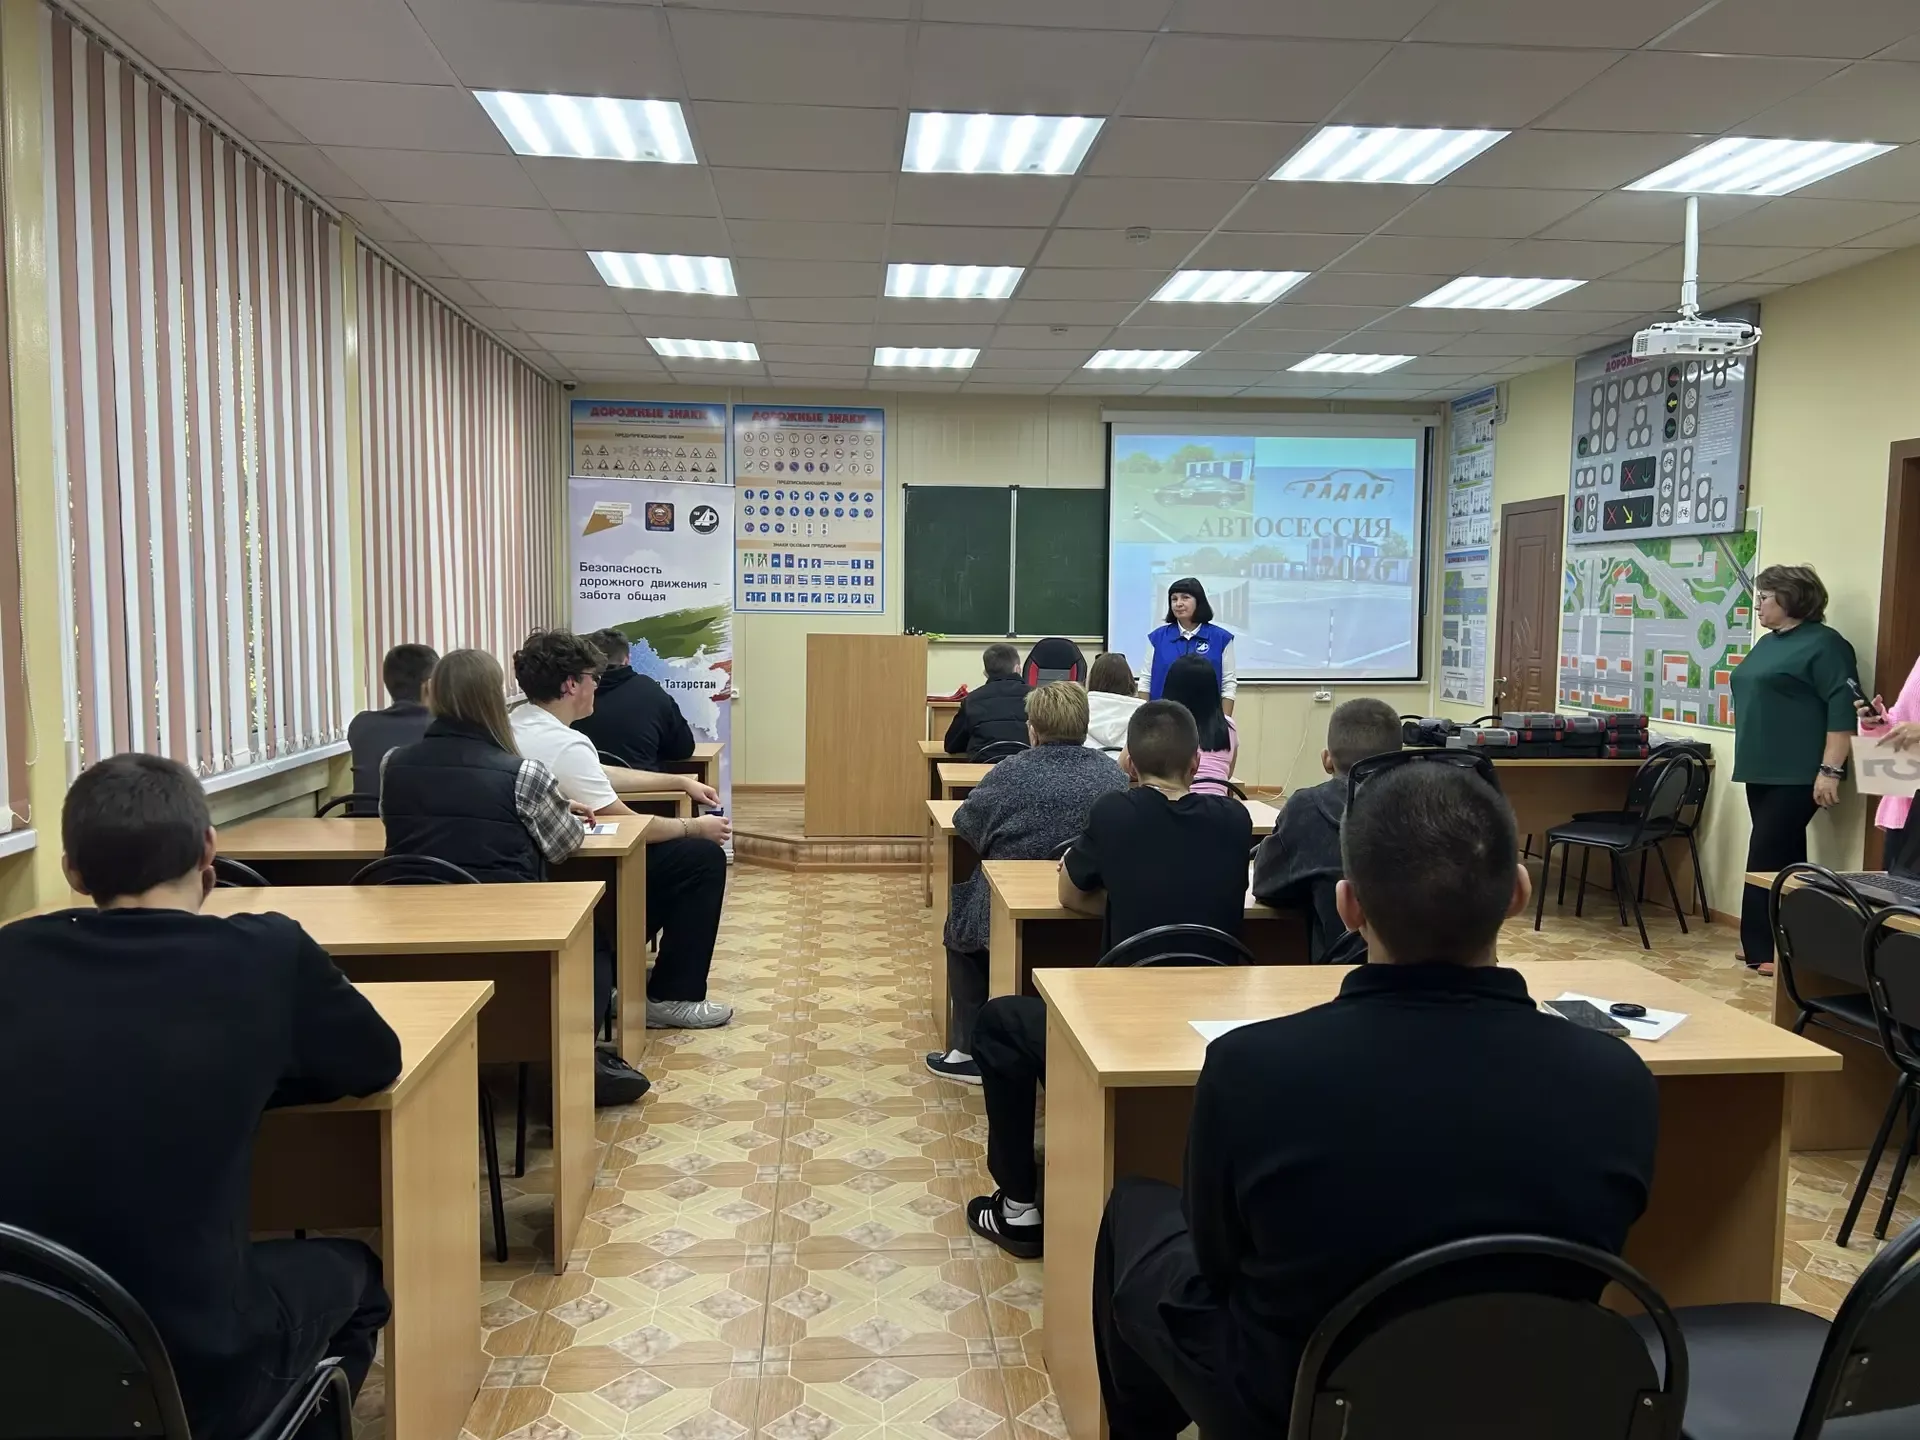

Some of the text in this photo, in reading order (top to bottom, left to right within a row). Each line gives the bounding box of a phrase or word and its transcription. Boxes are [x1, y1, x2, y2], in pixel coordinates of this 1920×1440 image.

[590, 406, 708, 420] ДОРОЖНЫЕ ЗНАКИ
[752, 410, 867, 424] ДОРОЖНЫЕ ЗНАКИ
[1302, 482, 1386, 502] РАДАР
[1197, 516, 1393, 538] АВТОСЕССИЯ
[579, 562, 663, 574] Безопасность
[1318, 555, 1394, 581] 2026
[579, 578, 645, 588] дорожного
[650, 580, 708, 589] движения
[579, 590, 666, 602] забота общая
[665, 679, 717, 690] Татарстан
